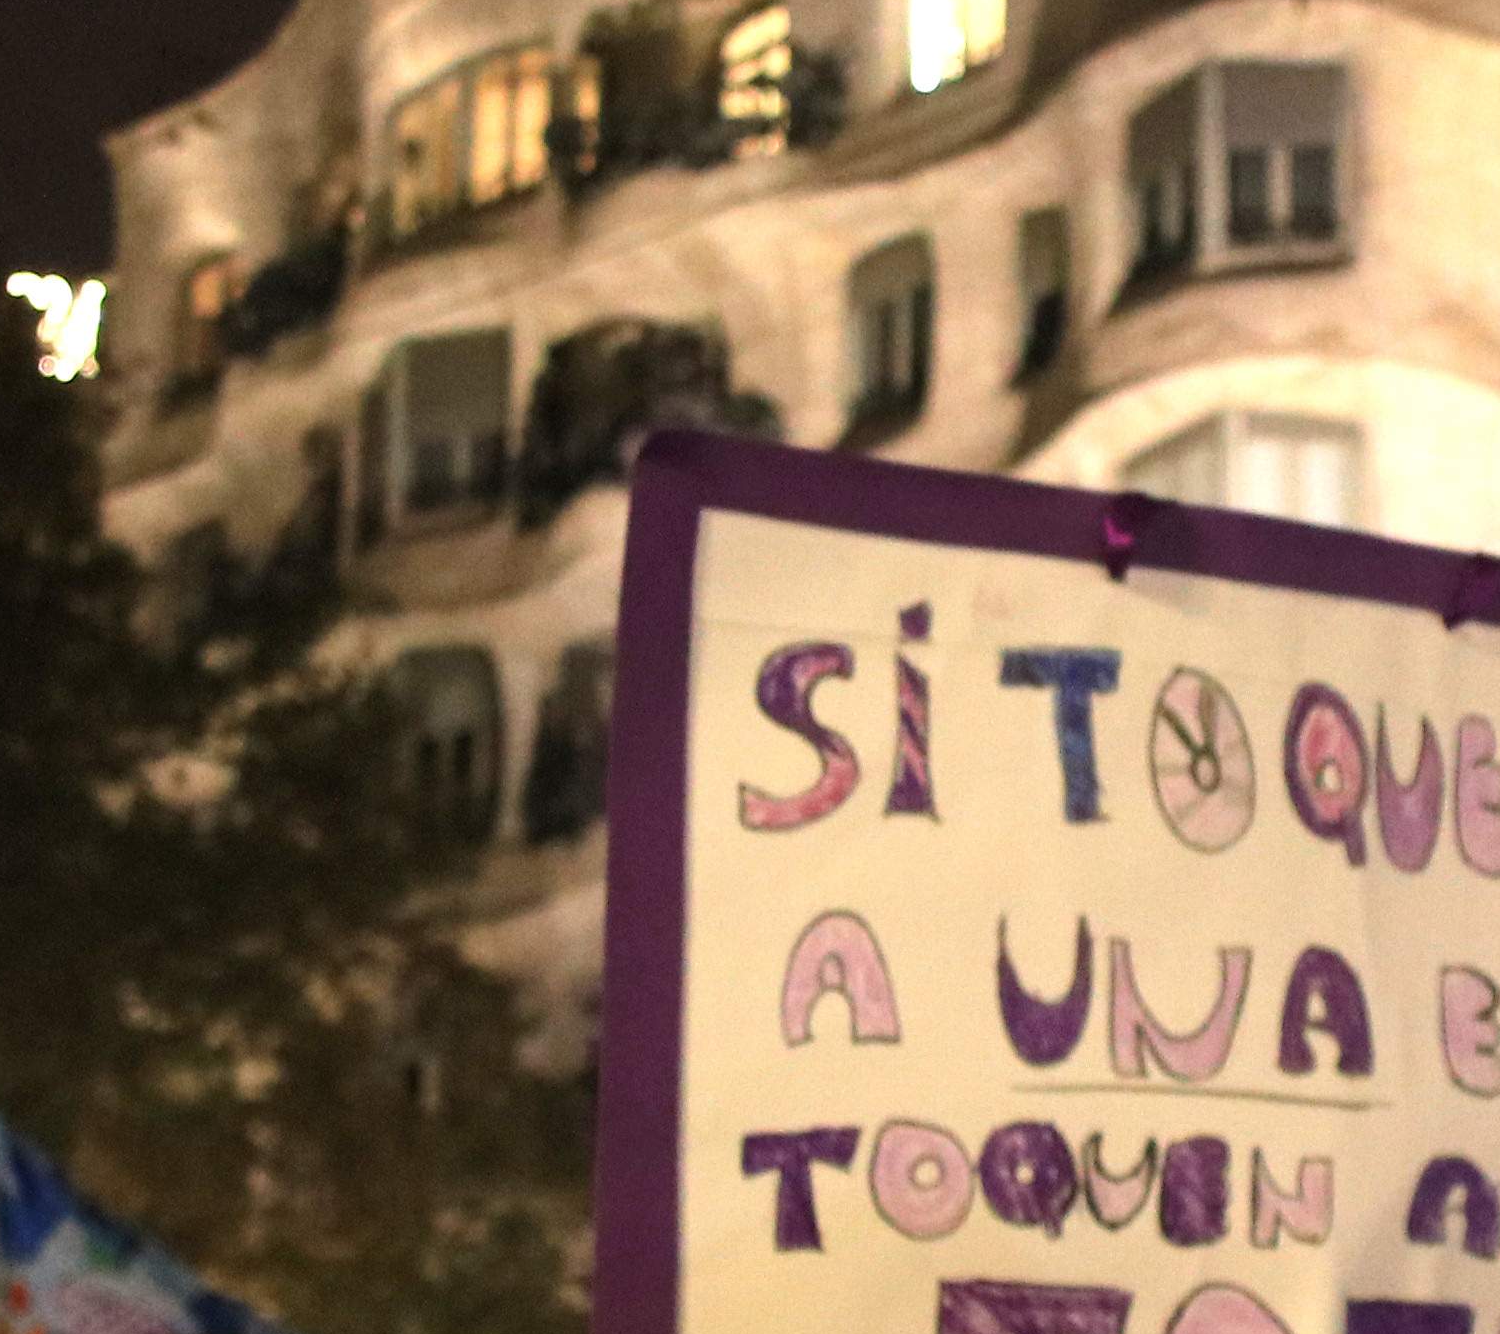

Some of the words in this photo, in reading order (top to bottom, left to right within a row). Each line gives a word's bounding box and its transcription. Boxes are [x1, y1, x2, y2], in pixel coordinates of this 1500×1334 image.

[738, 601, 940, 832] Si
[780, 910, 902, 1048] A
[997, 911, 1376, 1083] UNA
[740, 1117, 1334, 1253] TOQUEN
[1405, 1153, 1500, 1261] A
